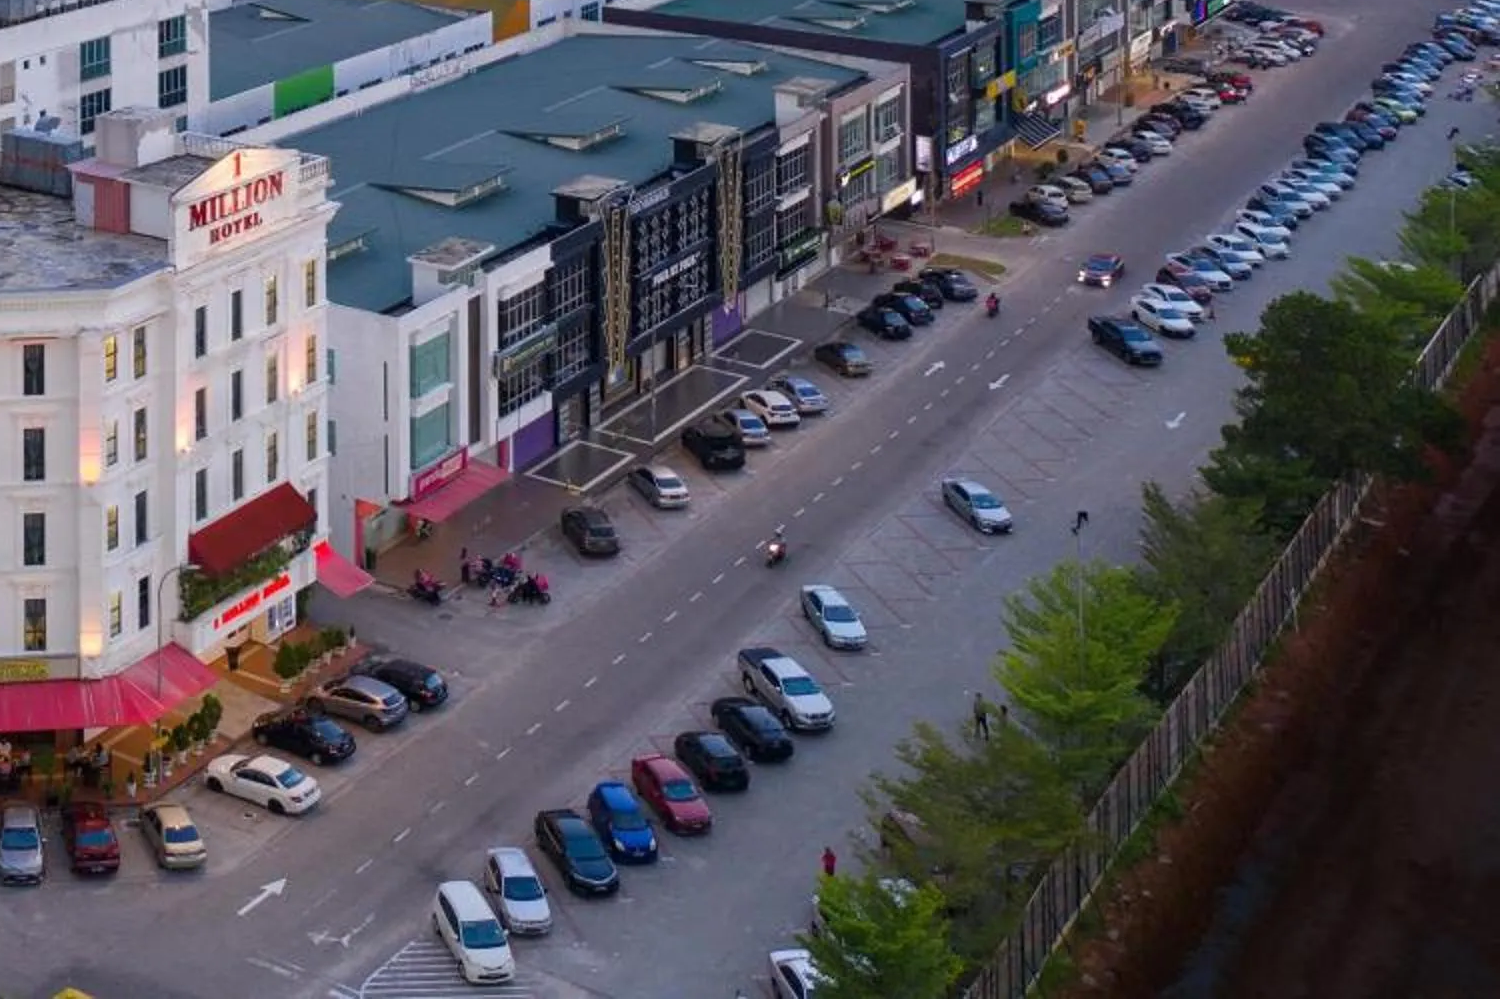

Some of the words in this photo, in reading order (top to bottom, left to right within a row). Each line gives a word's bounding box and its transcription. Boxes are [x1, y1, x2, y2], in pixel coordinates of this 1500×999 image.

[233, 152, 242, 177] 1
[189, 170, 284, 232] MILLION
[209, 212, 263, 245] HOTEL
